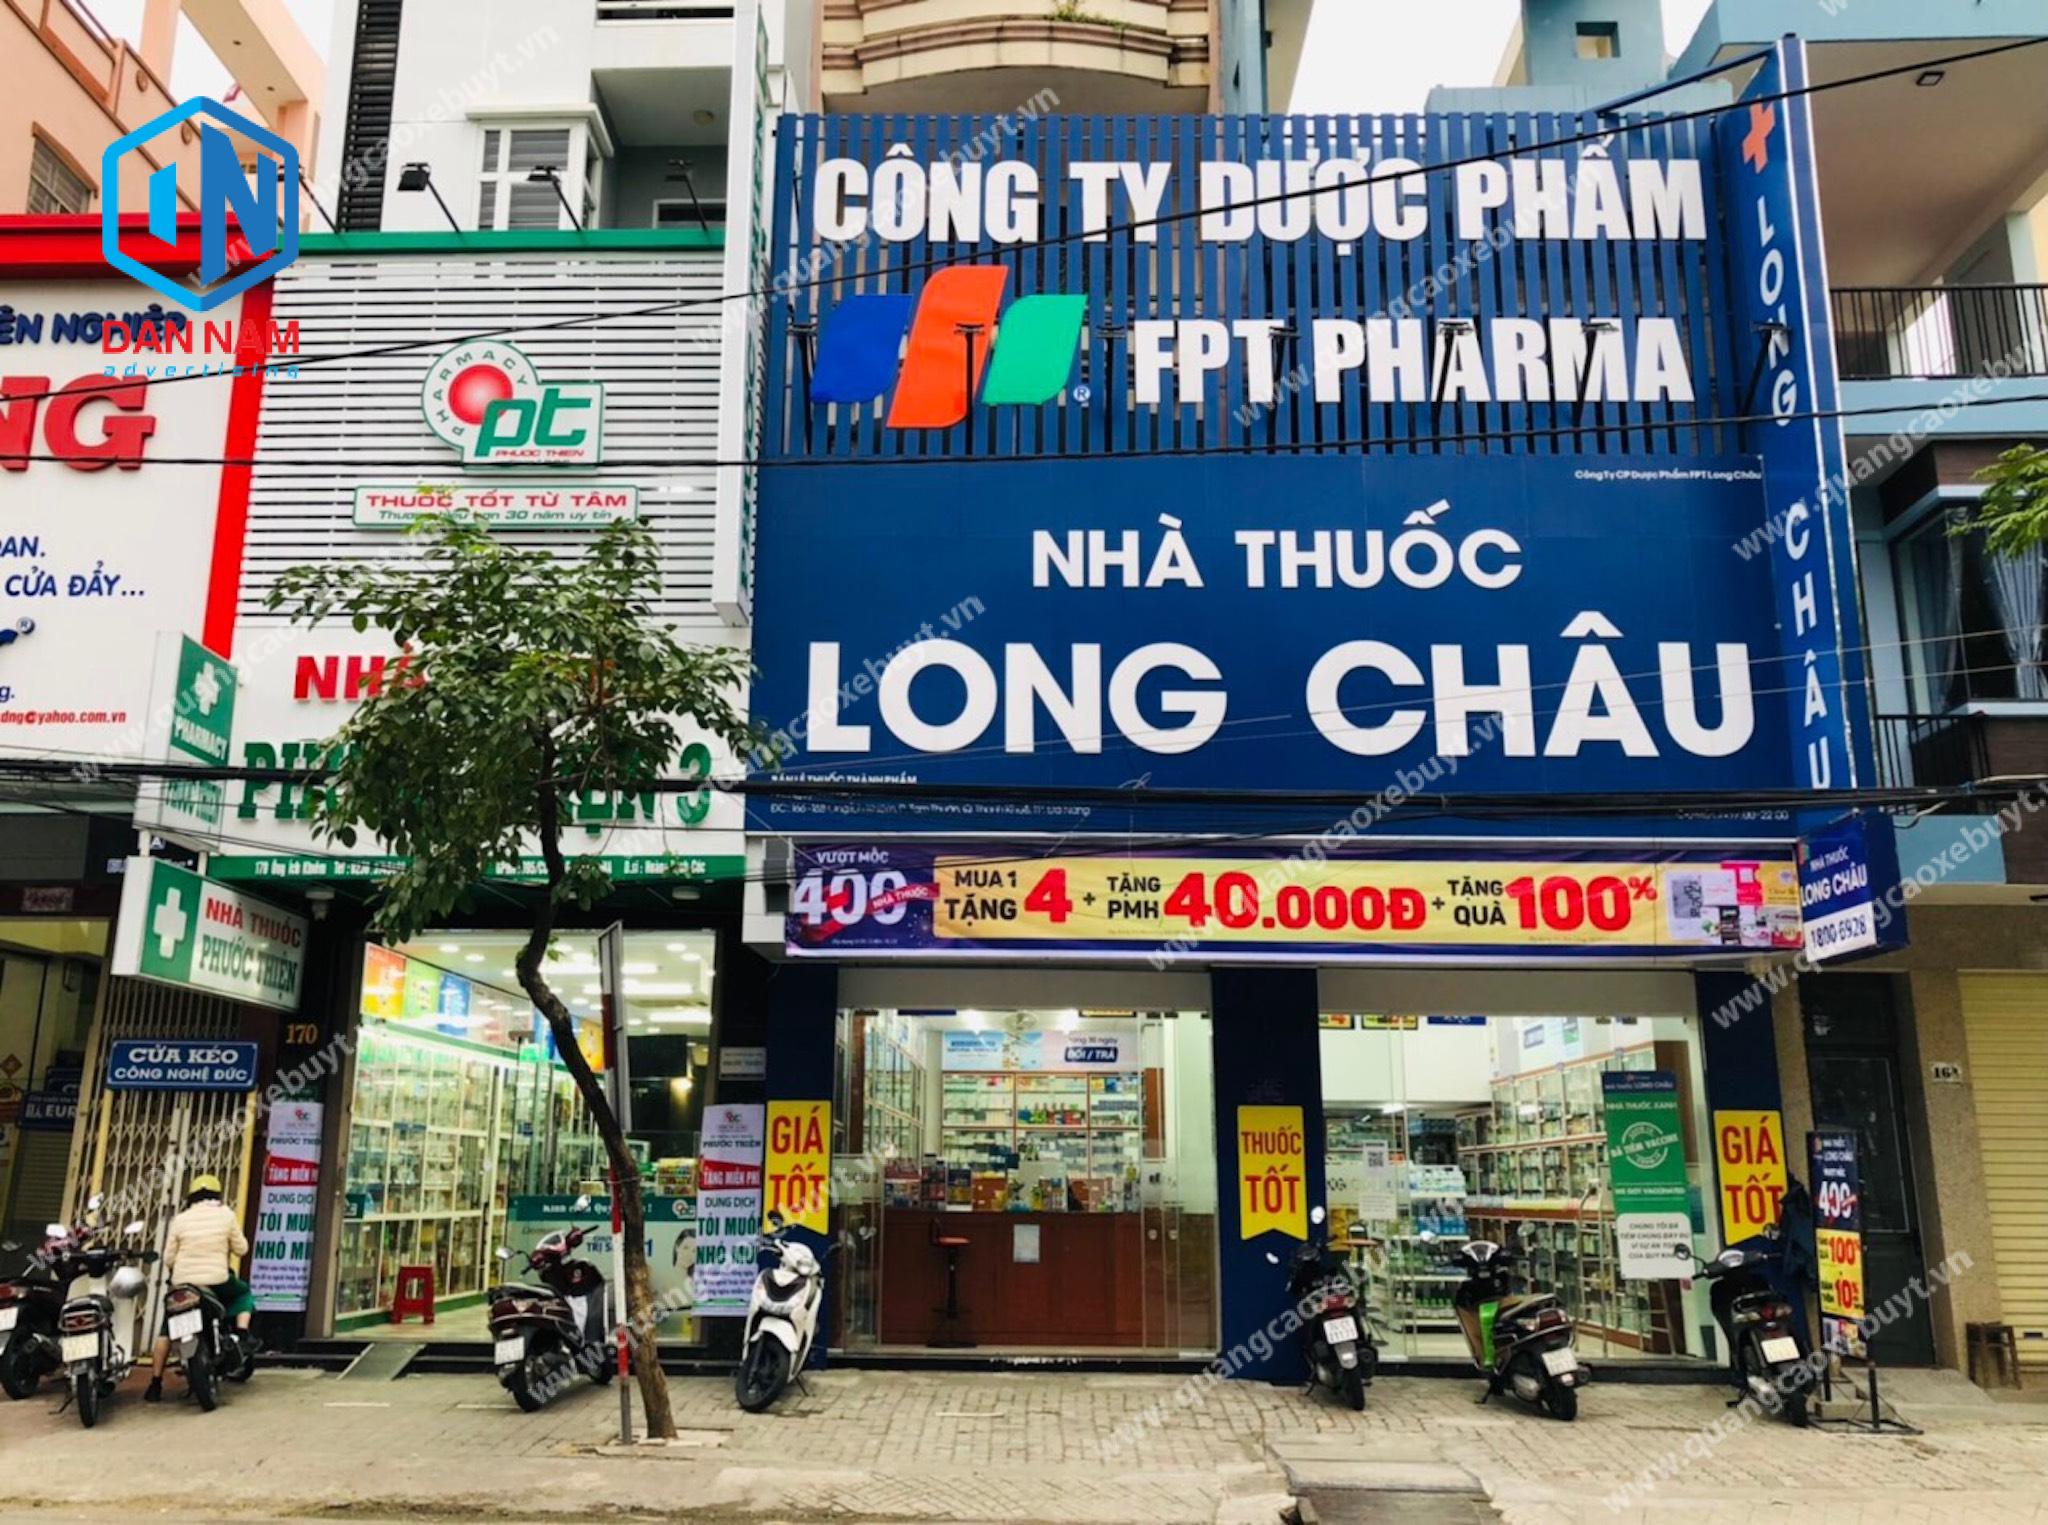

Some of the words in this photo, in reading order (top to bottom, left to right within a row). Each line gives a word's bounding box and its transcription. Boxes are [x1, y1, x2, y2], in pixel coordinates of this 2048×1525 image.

[813, 143, 1039, 243] CÔNG
[1069, 161, 1171, 242] TY
[1200, 148, 1428, 256] DƯỢC
[1456, 134, 1706, 240] PHẨM
[1134, 320, 1284, 403] FPT
[1311, 318, 1695, 403] PHARMA
[433, 349, 527, 437] PHARMACY
[465, 489, 515, 508] TỐT
[571, 493, 628, 508] TÂM
[505, 509, 528, 520] 30
[570, 511, 586, 522] uy
[1033, 513, 1204, 588] NHÀ
[1234, 499, 1522, 589] THUỐC
[5, 565, 58, 597] CỬA
[1785, 502, 1831, 790] CHÂU
[806, 638, 1228, 755] LONG
[1305, 611, 1756, 757] CHÂU
[794, 868, 908, 926] 400
[955, 870, 1003, 888] MUA
[1024, 867, 1074, 924] 4
[1107, 872, 1161, 897] TẶNG
[1447, 879, 1504, 902] TẶNG
[1832, 863, 1868, 896] CHÂU
[205, 898, 244, 930] NHÀ
[251, 912, 301, 949] THUỐC
[945, 893, 1018, 927] TẶNG
[1107, 901, 1160, 920] PMH
[1454, 901, 1506, 926] QUÀ
[199, 934, 252, 981] PHƯỚC
[129, 1044, 181, 1064] CỬA
[187, 1044, 239, 1064] KÉO
[285, 1022, 319, 1044] 170
[114, 1064, 162, 1080] CÔNG
[167, 1065, 209, 1082] NGHỆ
[214, 1064, 249, 1081] ĐỨC
[771, 1105, 824, 1155] GIÁ
[1241, 1123, 1302, 1156] THUỐC
[1721, 1115, 1778, 1166] GIÁ
[769, 1163, 825, 1214] TỐT
[1245, 1164, 1301, 1214] TỐT
[1725, 1171, 1783, 1226] TỐT
